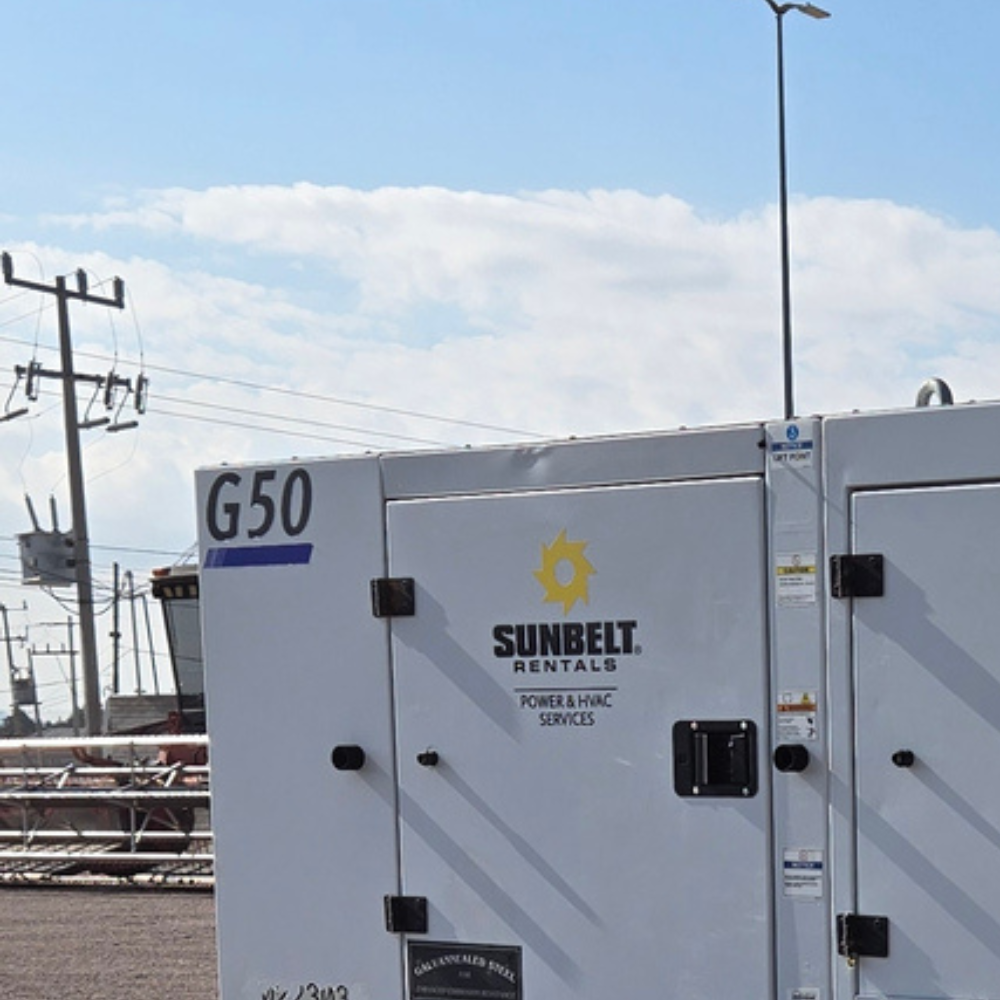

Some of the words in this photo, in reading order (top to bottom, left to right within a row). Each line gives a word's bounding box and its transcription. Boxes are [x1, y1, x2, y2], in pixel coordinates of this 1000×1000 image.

[206, 468, 312, 541] G50
[493, 620, 638, 658] SUNBELT
[514, 658, 617, 673] RENTALS
[520, 694, 564, 709] POWER
[566, 694, 575, 709] &
[578, 693, 612, 708] HVAC
[539, 711, 595, 726] SERVICES
